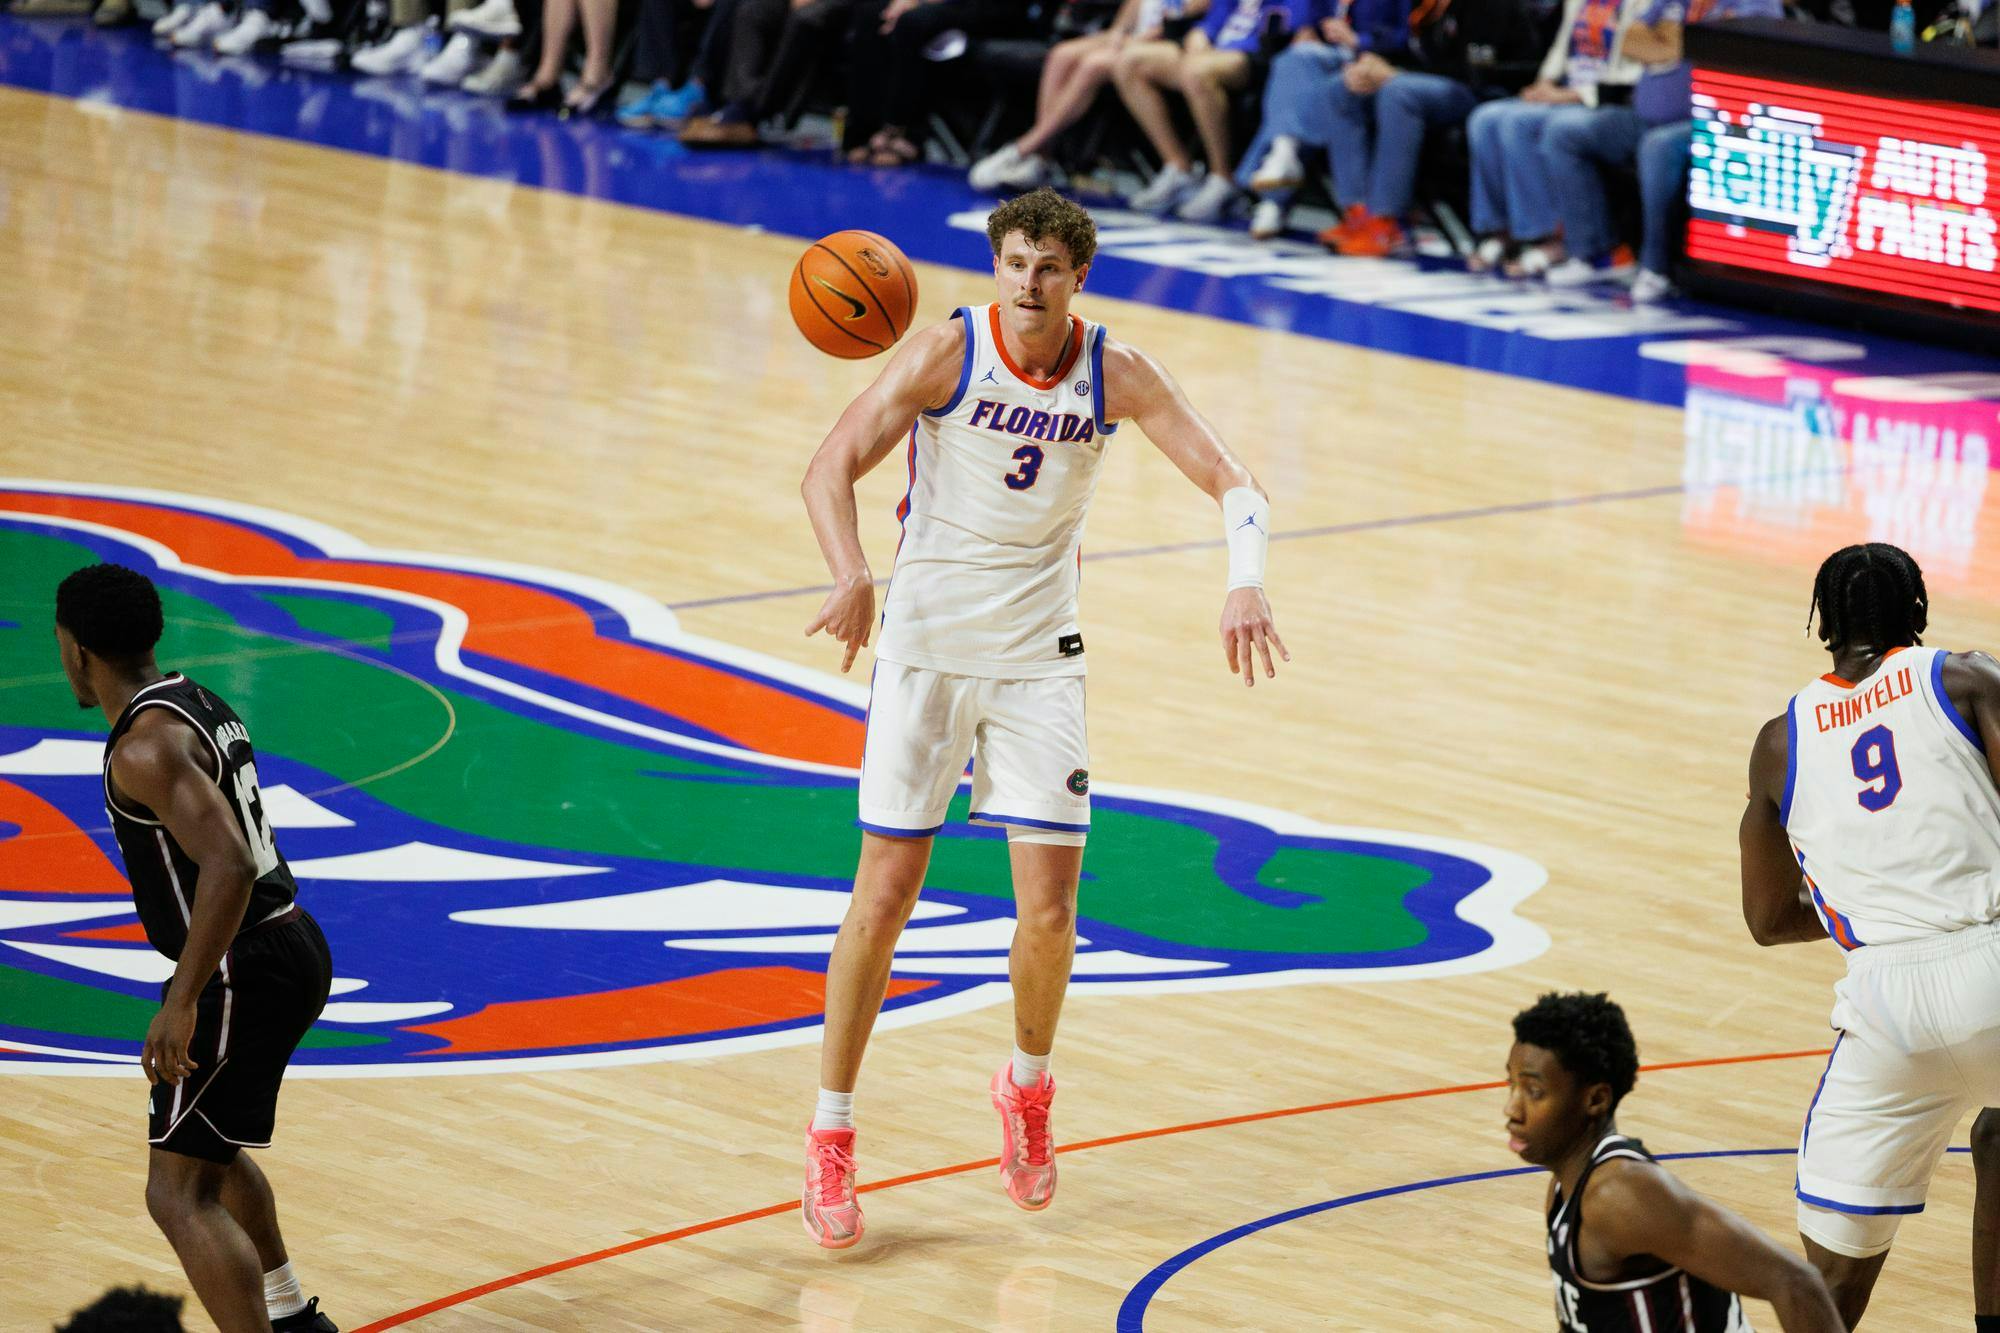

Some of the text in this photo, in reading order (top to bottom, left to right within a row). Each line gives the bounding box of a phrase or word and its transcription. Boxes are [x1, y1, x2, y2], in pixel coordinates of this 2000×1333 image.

[1871, 136, 1987, 205] AUTO
[1857, 197, 1997, 272] PARTS
[967, 399, 1094, 443] FLORIDA
[1075, 381, 1090, 396] SEC
[1004, 445, 1045, 490] 3
[1815, 667, 1913, 733] CHINYELU
[1850, 723, 1903, 813] 9
[233, 761, 279, 880] 12
